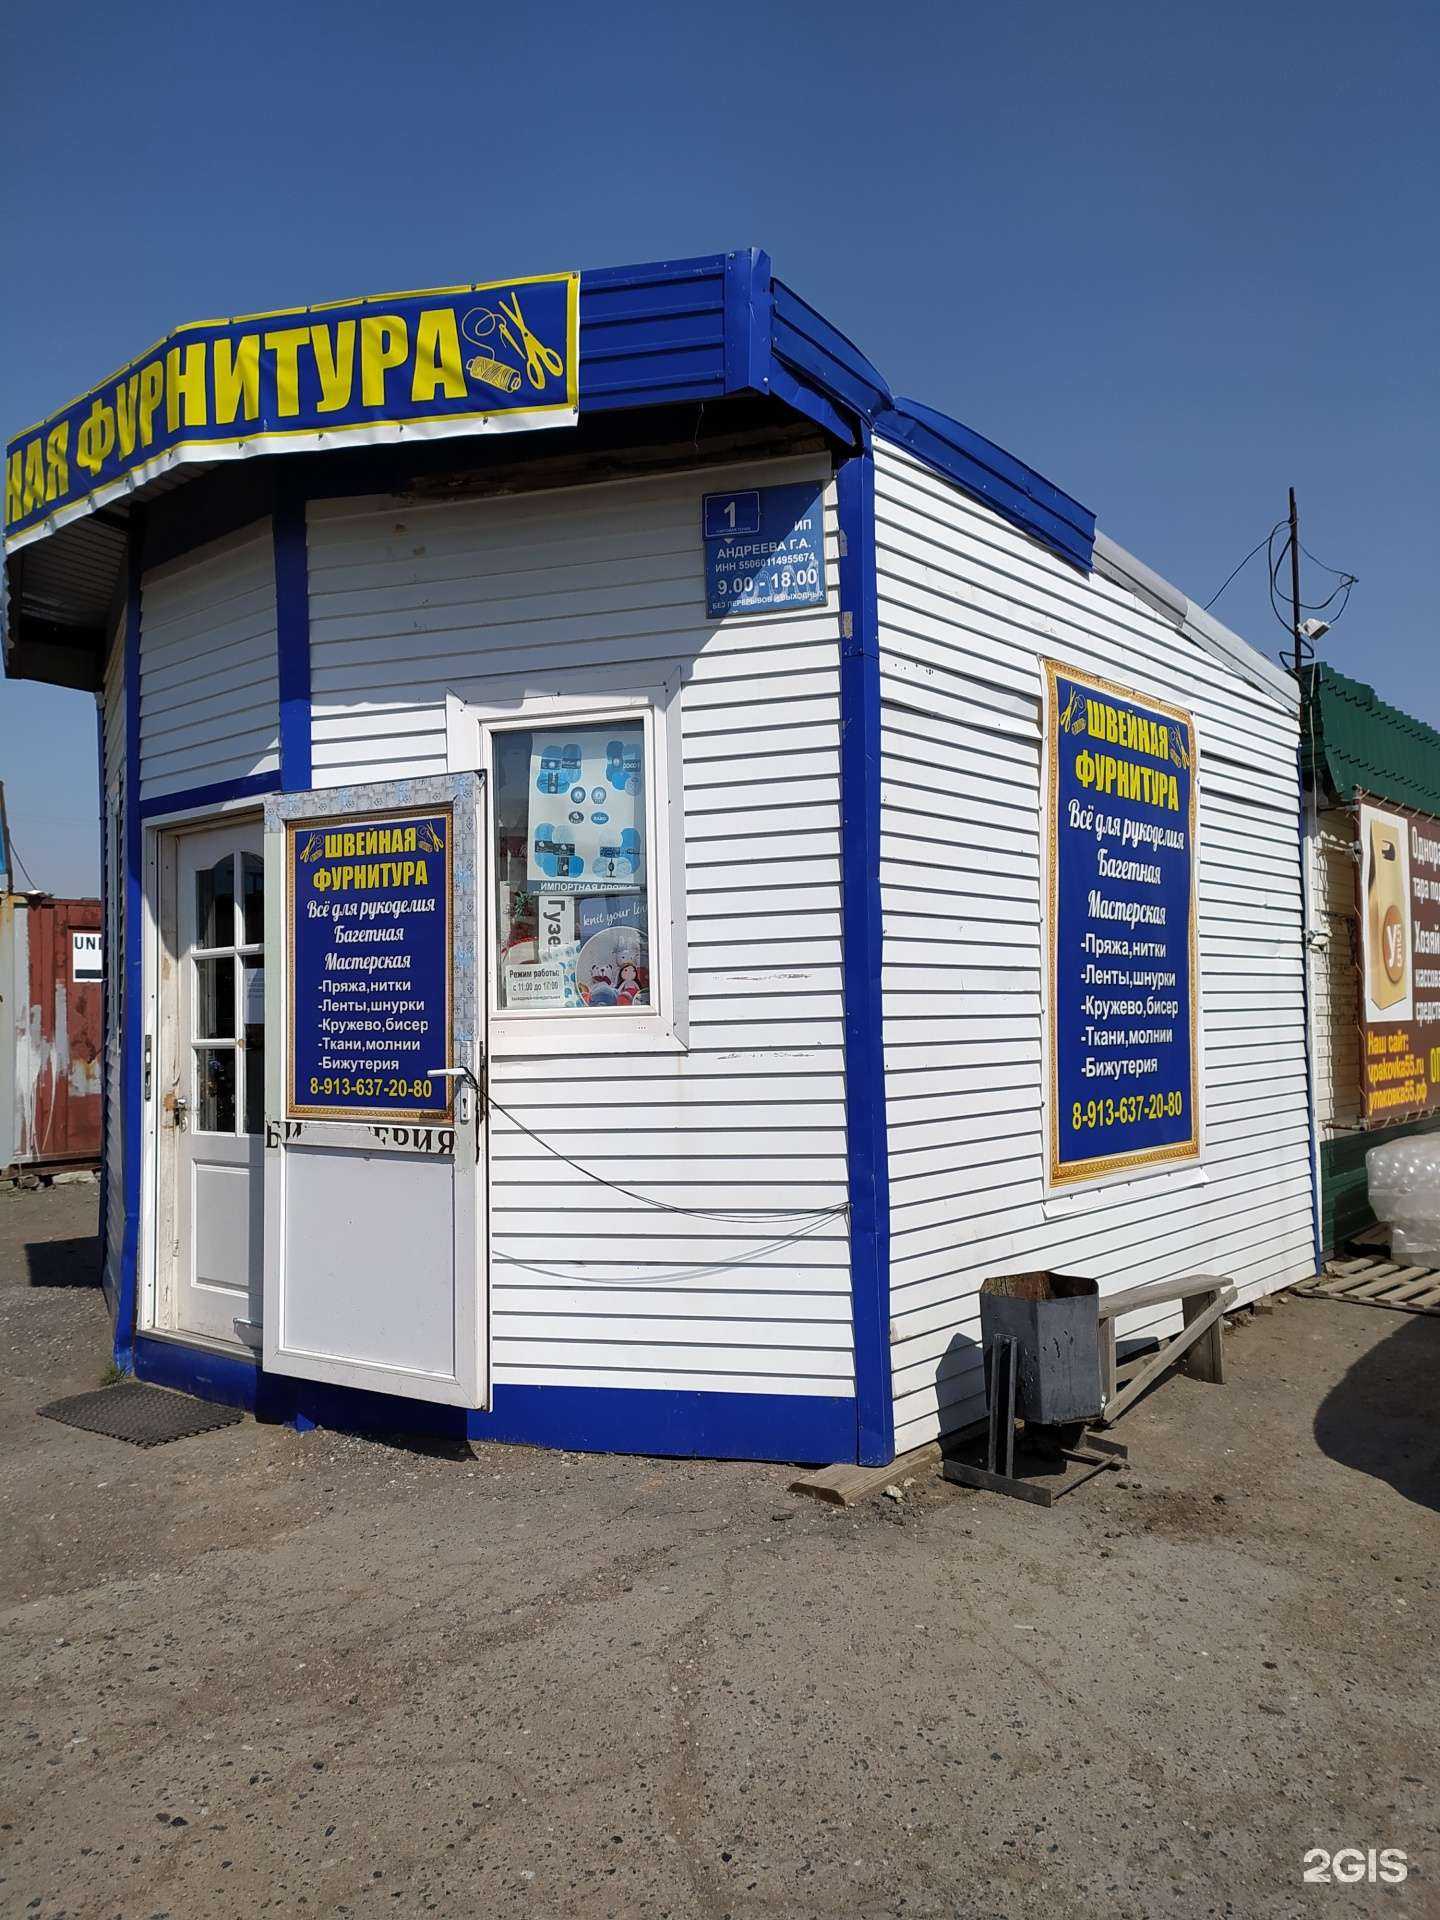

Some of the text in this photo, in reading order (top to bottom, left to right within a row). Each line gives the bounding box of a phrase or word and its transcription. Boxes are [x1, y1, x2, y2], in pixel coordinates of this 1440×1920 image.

[76, 308, 468, 476] ФУРНИТУРА
[724, 502, 736, 528] 1
[794, 519, 812, 531] ИП
[717, 538, 811, 559] АНДРЕЕВА Г.А.
[715, 563, 736, 573] ИНН
[718, 576, 754, 595] 9.00
[771, 568, 818, 589] 18.00
[1086, 700, 1169, 761] ШВЕЙНАЯ
[1075, 749, 1179, 812] ФУРНИТУРА
[1068, 799, 1185, 852] Всё для рукоделия
[324, 827, 417, 858] ШВЕЙНАЯ
[313, 860, 428, 892] ФУРНИТУРА
[1097, 847, 1162, 885] Багетная
[540, 882, 598, 891] ИМПОРТНАЯ
[307, 898, 435, 922] Всё для рукоделия
[606, 909, 630, 926] your
[1088, 889, 1167, 930] Мастерская
[334, 925, 404, 943] Багетная
[1080, 933, 1167, 959] -Пряжа,нитки
[324, 952, 411, 974] Мастерская
[509, 970, 532, 978] Режим
[318, 980, 411, 995] -Пряжа,нитки
[1080, 964, 1176, 991] -Ленты,шнурки
[318, 999, 425, 1014] -Ленты,шнурки
[1080, 995, 1179, 1020] -Кружево,бисер
[318, 1018, 429, 1034] -Кружево,бисер
[1080, 1026, 1173, 1046] -Ткани,молнии
[318, 1037, 421, 1052] -Ткани,молнии
[1368, 1031, 1387, 1055] Наш
[318, 1056, 399, 1073] -Бижутерия
[1081, 1056, 1158, 1081] -Бижутерия
[310, 1077, 432, 1098] 8-913-637-20-80
[1072, 1090, 1183, 1131] 8-913-637-20-80
